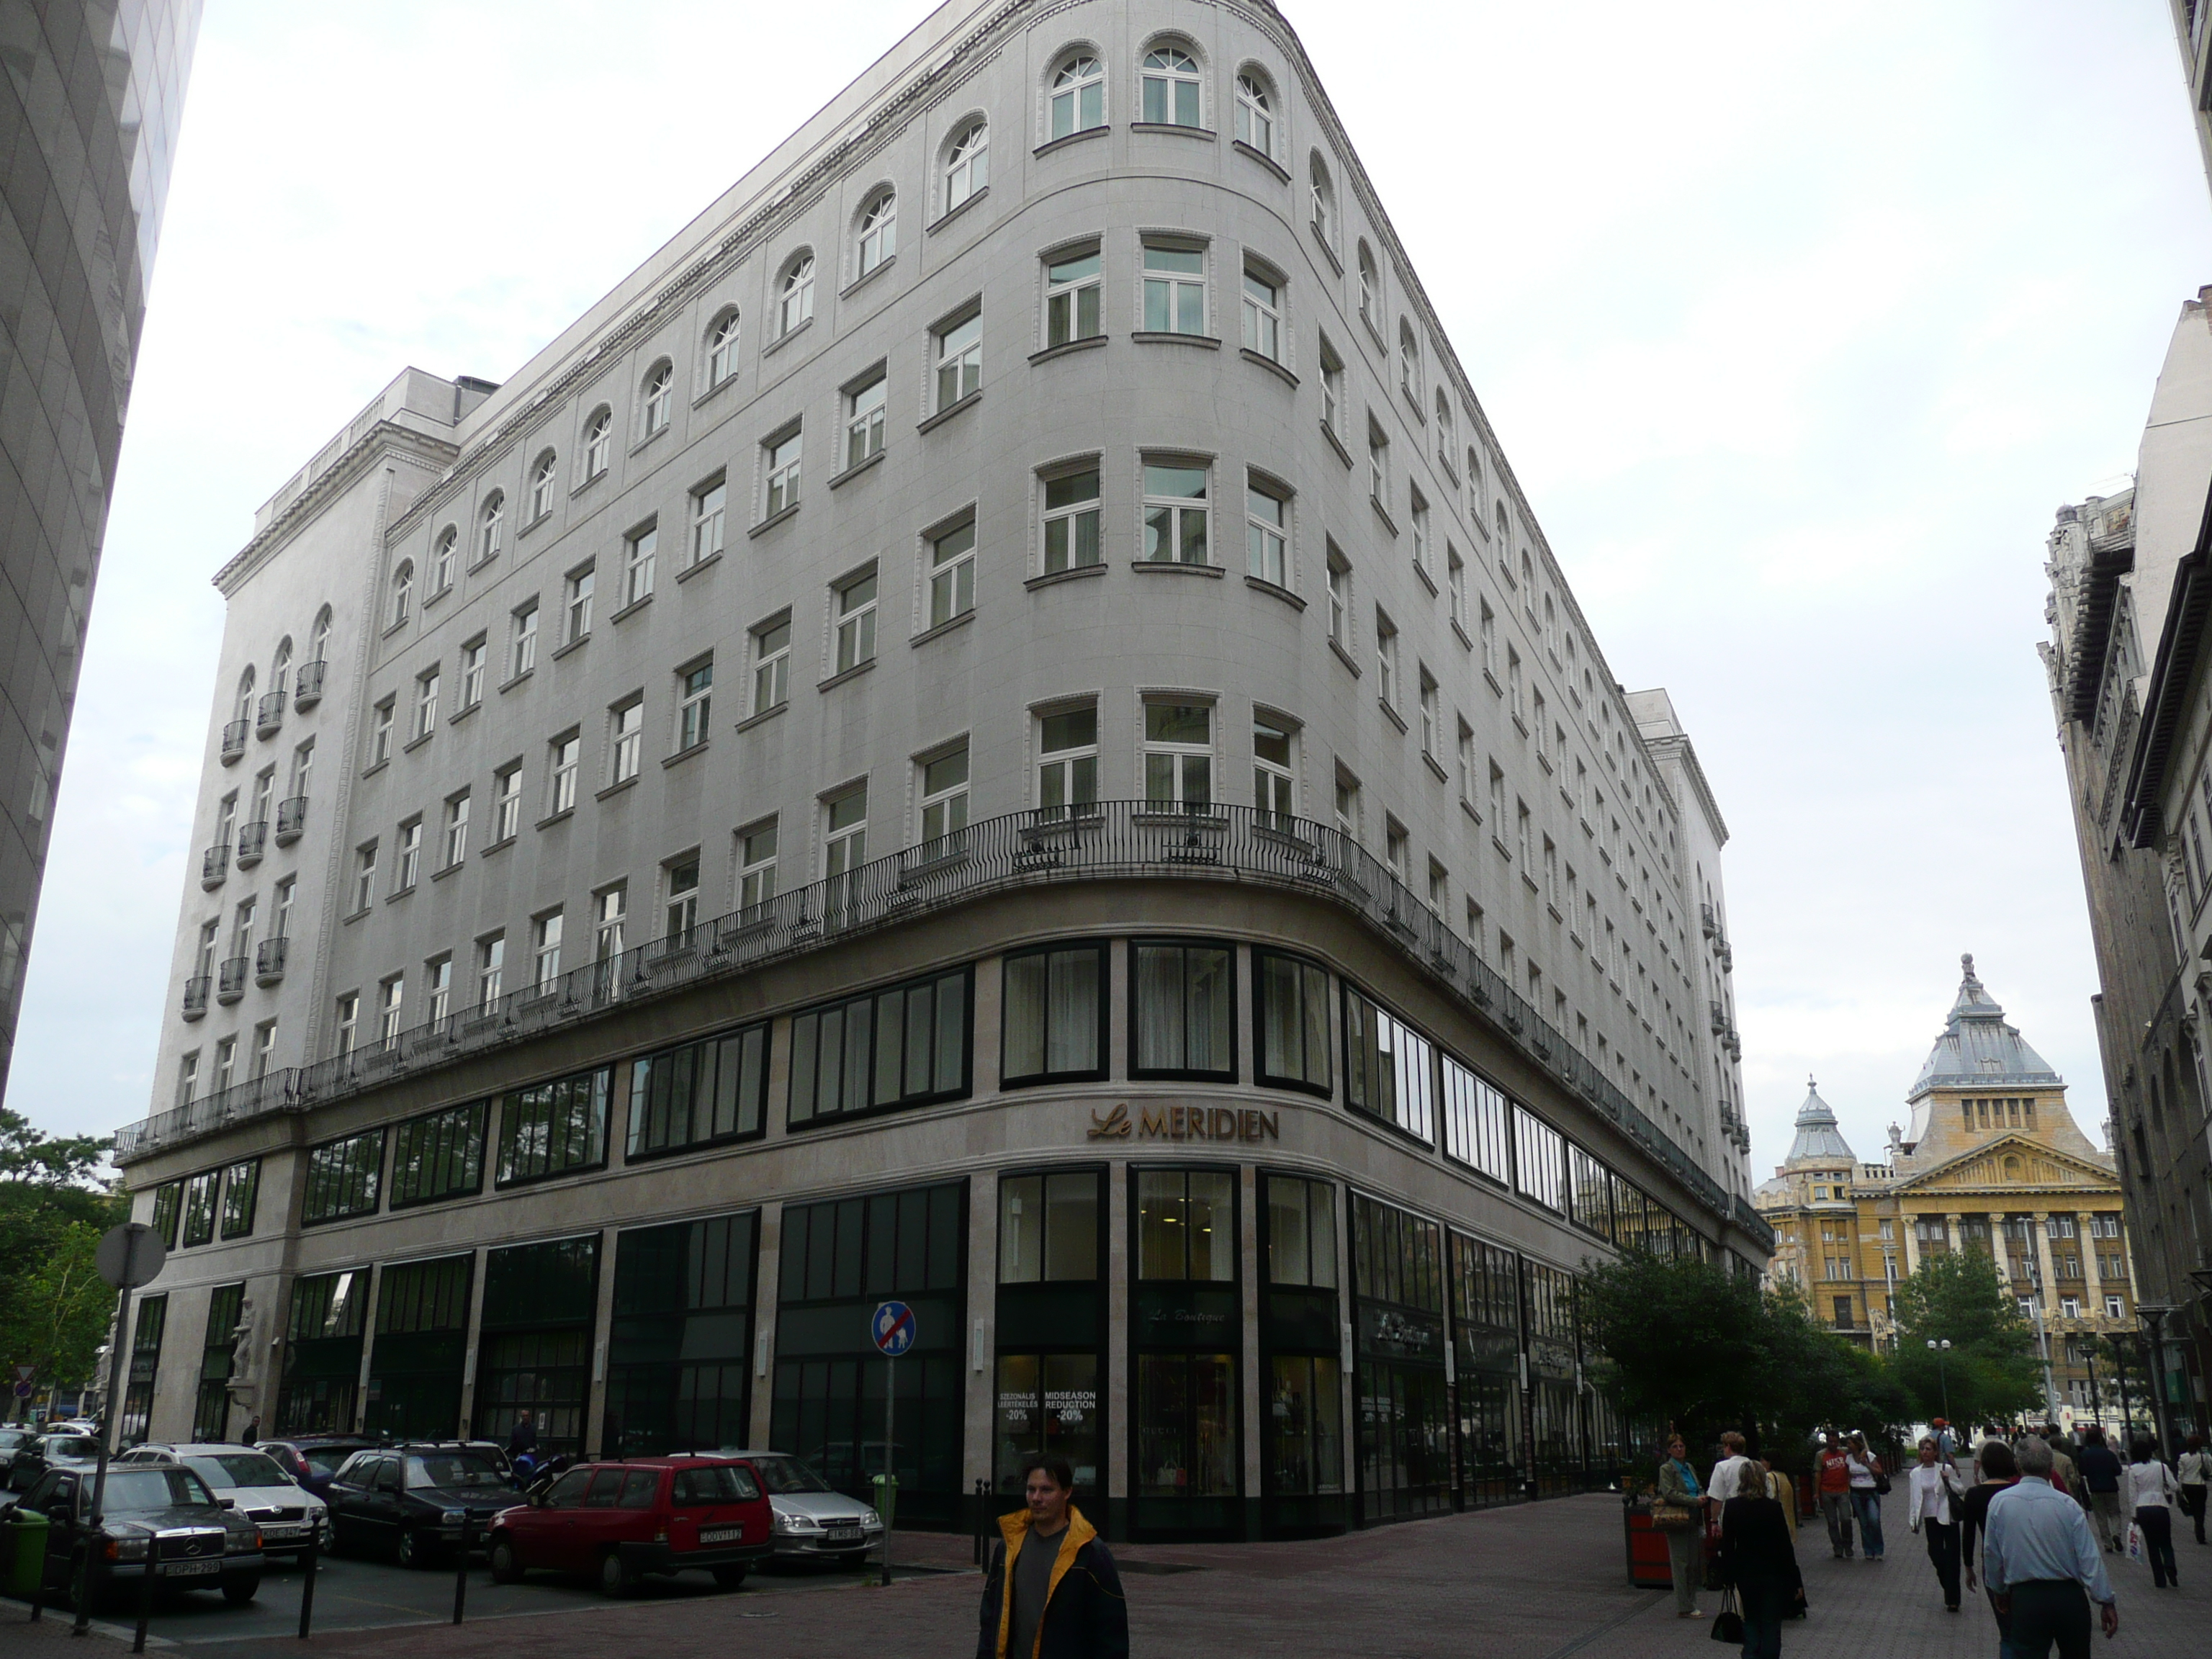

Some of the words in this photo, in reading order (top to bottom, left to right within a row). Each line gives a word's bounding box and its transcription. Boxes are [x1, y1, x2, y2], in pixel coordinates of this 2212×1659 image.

[1087, 1103, 1132, 1136] Le
[1139, 1106, 1279, 1140] MERIDIEN
[1174, 1309, 1226, 1325] Boutique
[1045, 1391, 1096, 1401] MIDSEASON
[1045, 1401, 1096, 1409] REDUCTION
[1006, 1410, 1028, 1421] -20%
[1056, 1410, 1083, 1421] -20%
